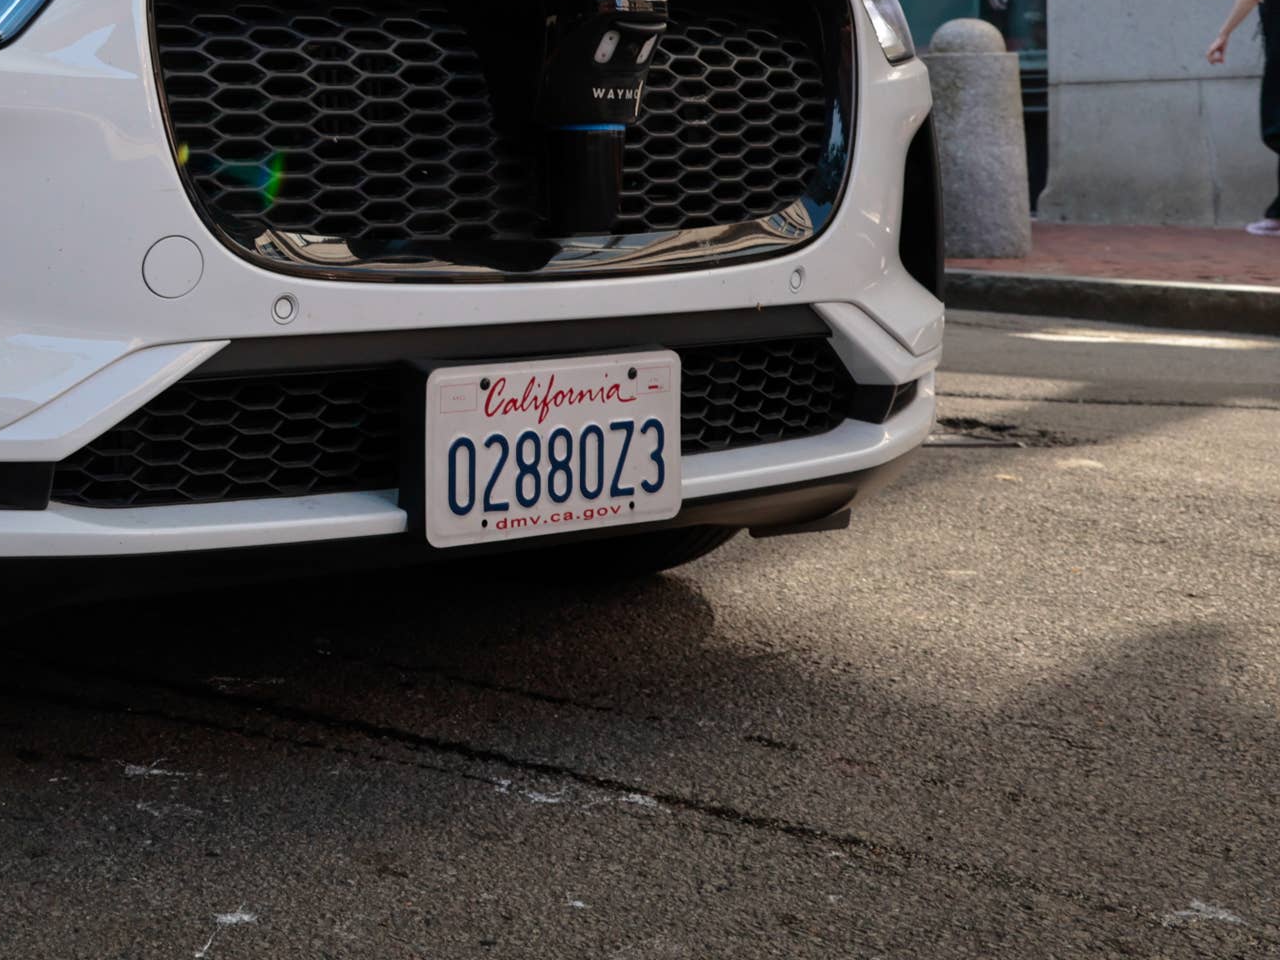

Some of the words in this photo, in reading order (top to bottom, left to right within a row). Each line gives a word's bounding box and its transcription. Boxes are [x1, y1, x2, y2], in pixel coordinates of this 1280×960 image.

[592, 87, 640, 100] WAYMO
[484, 373, 637, 424] California
[448, 418, 665, 516] 02880Z3
[496, 505, 622, 530] dmv.ca.gov
